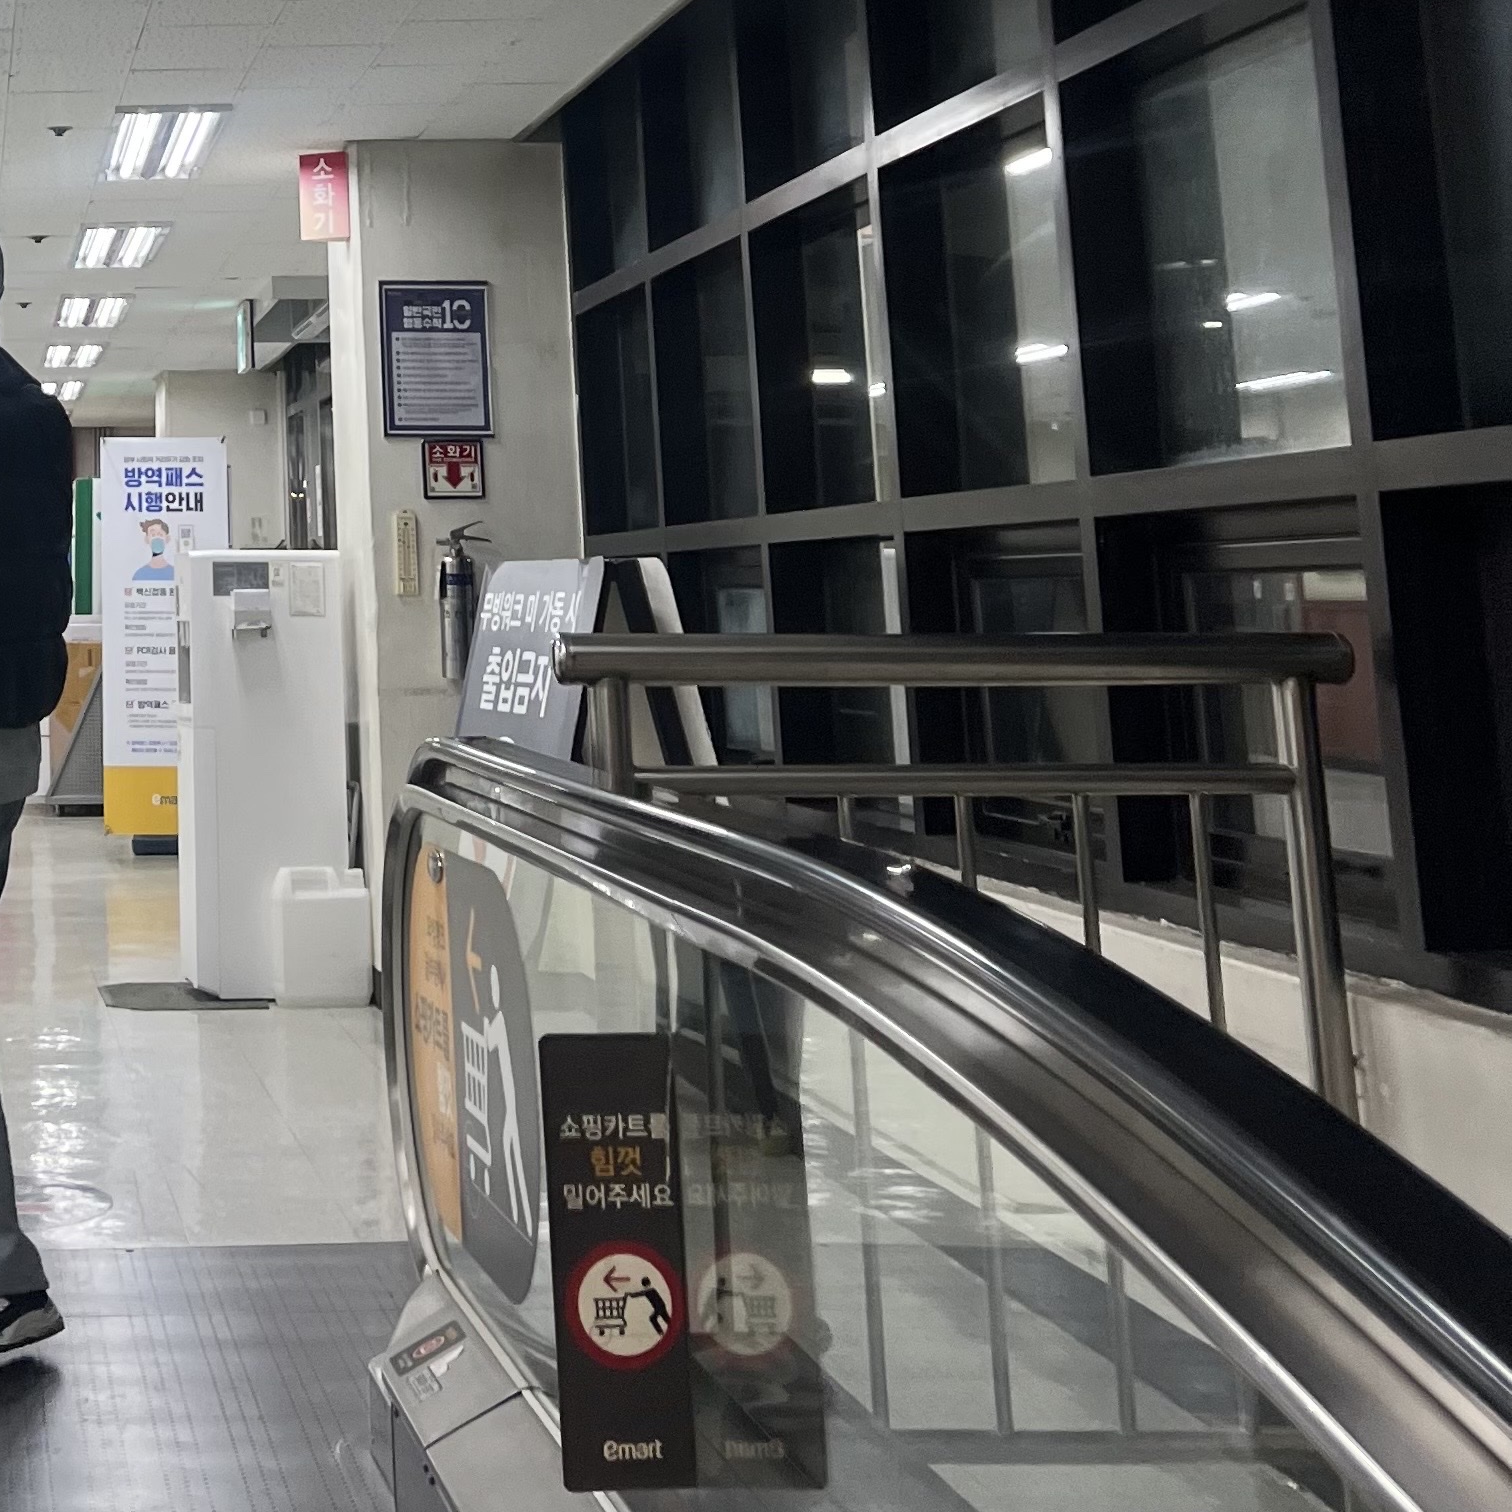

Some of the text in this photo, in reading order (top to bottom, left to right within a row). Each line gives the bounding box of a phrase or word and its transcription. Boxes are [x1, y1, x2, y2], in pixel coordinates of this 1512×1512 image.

[312, 157, 335, 234] 소화기
[431, 445, 475, 460] 소화기
[124, 467, 204, 487] 방역패스
[124, 491, 204, 513] 시행안내
[480, 590, 582, 634] 무빙워크 미 가동 시
[479, 646, 552, 718] 출입금지
[559, 1112, 667, 1141] 쇼핑카트를
[590, 1145, 643, 1177] 힘껏
[563, 1182, 675, 1211] 밀어주세요
[602, 1438, 664, 1462] emart
